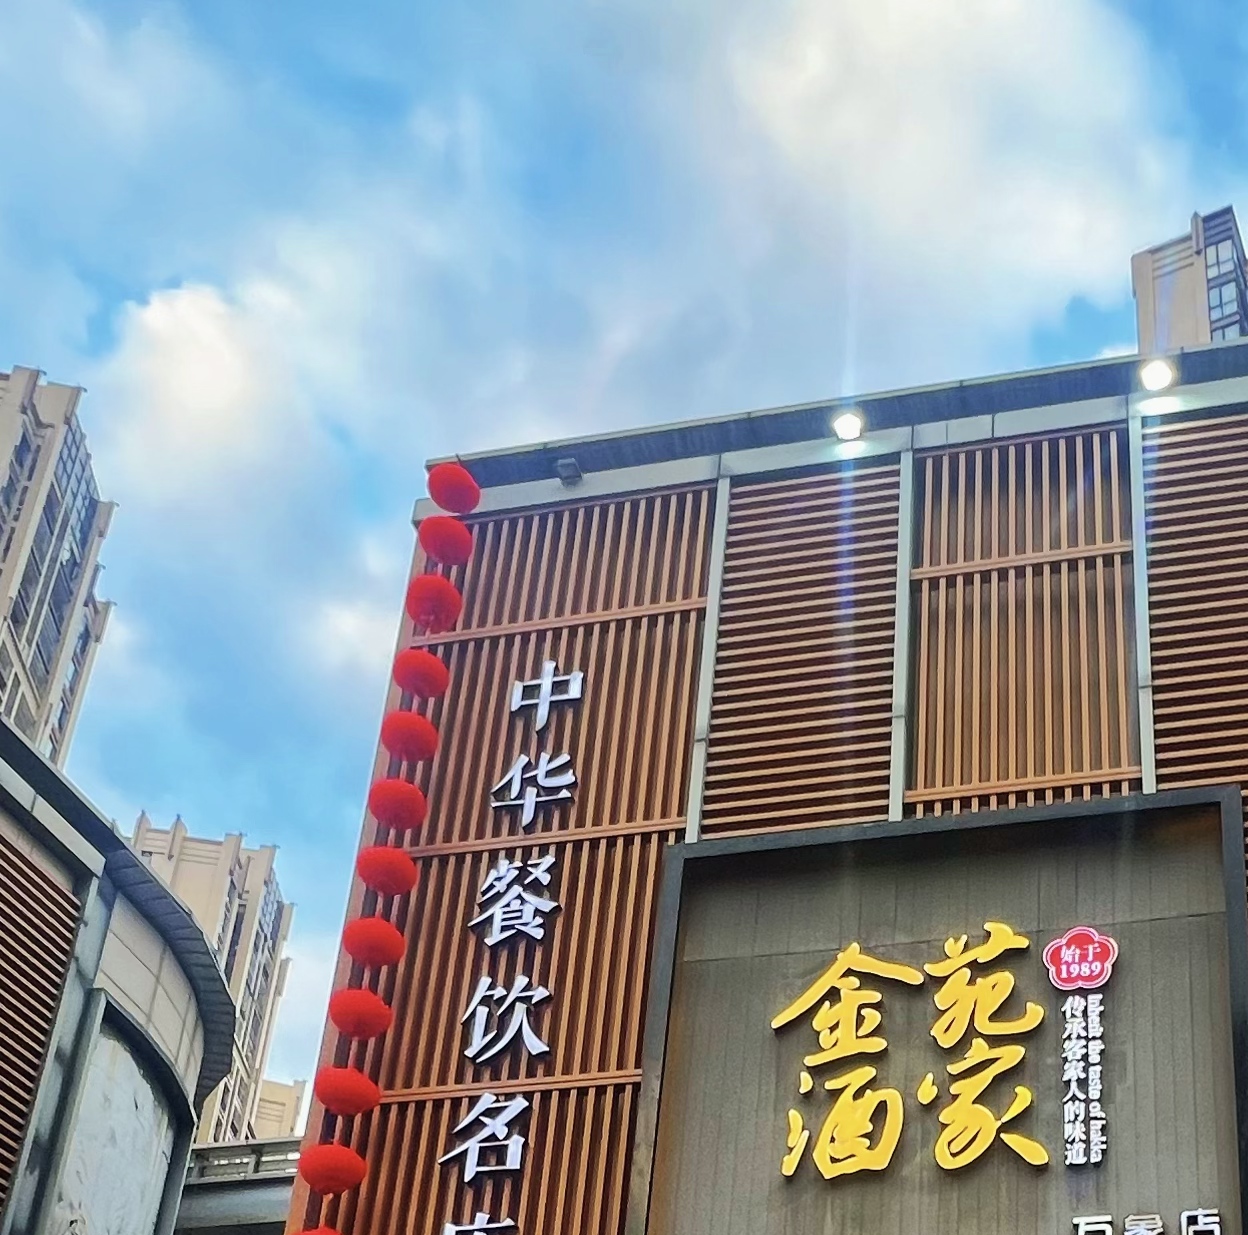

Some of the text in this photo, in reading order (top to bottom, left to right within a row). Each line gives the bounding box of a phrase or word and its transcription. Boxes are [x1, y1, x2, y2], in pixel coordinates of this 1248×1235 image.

[1060, 943, 1101, 963] 始于
[1059, 961, 1101, 979] 1989
[771, 921, 1045, 1067] 金苑
[1087, 1039, 1106, 1064] the
[1060, 995, 1088, 1166] 传承客家人的味道
[1087, 1065, 1103, 1100] taste
[781, 1038, 1050, 1181] 酒家
[1088, 1100, 1107, 1118] of
